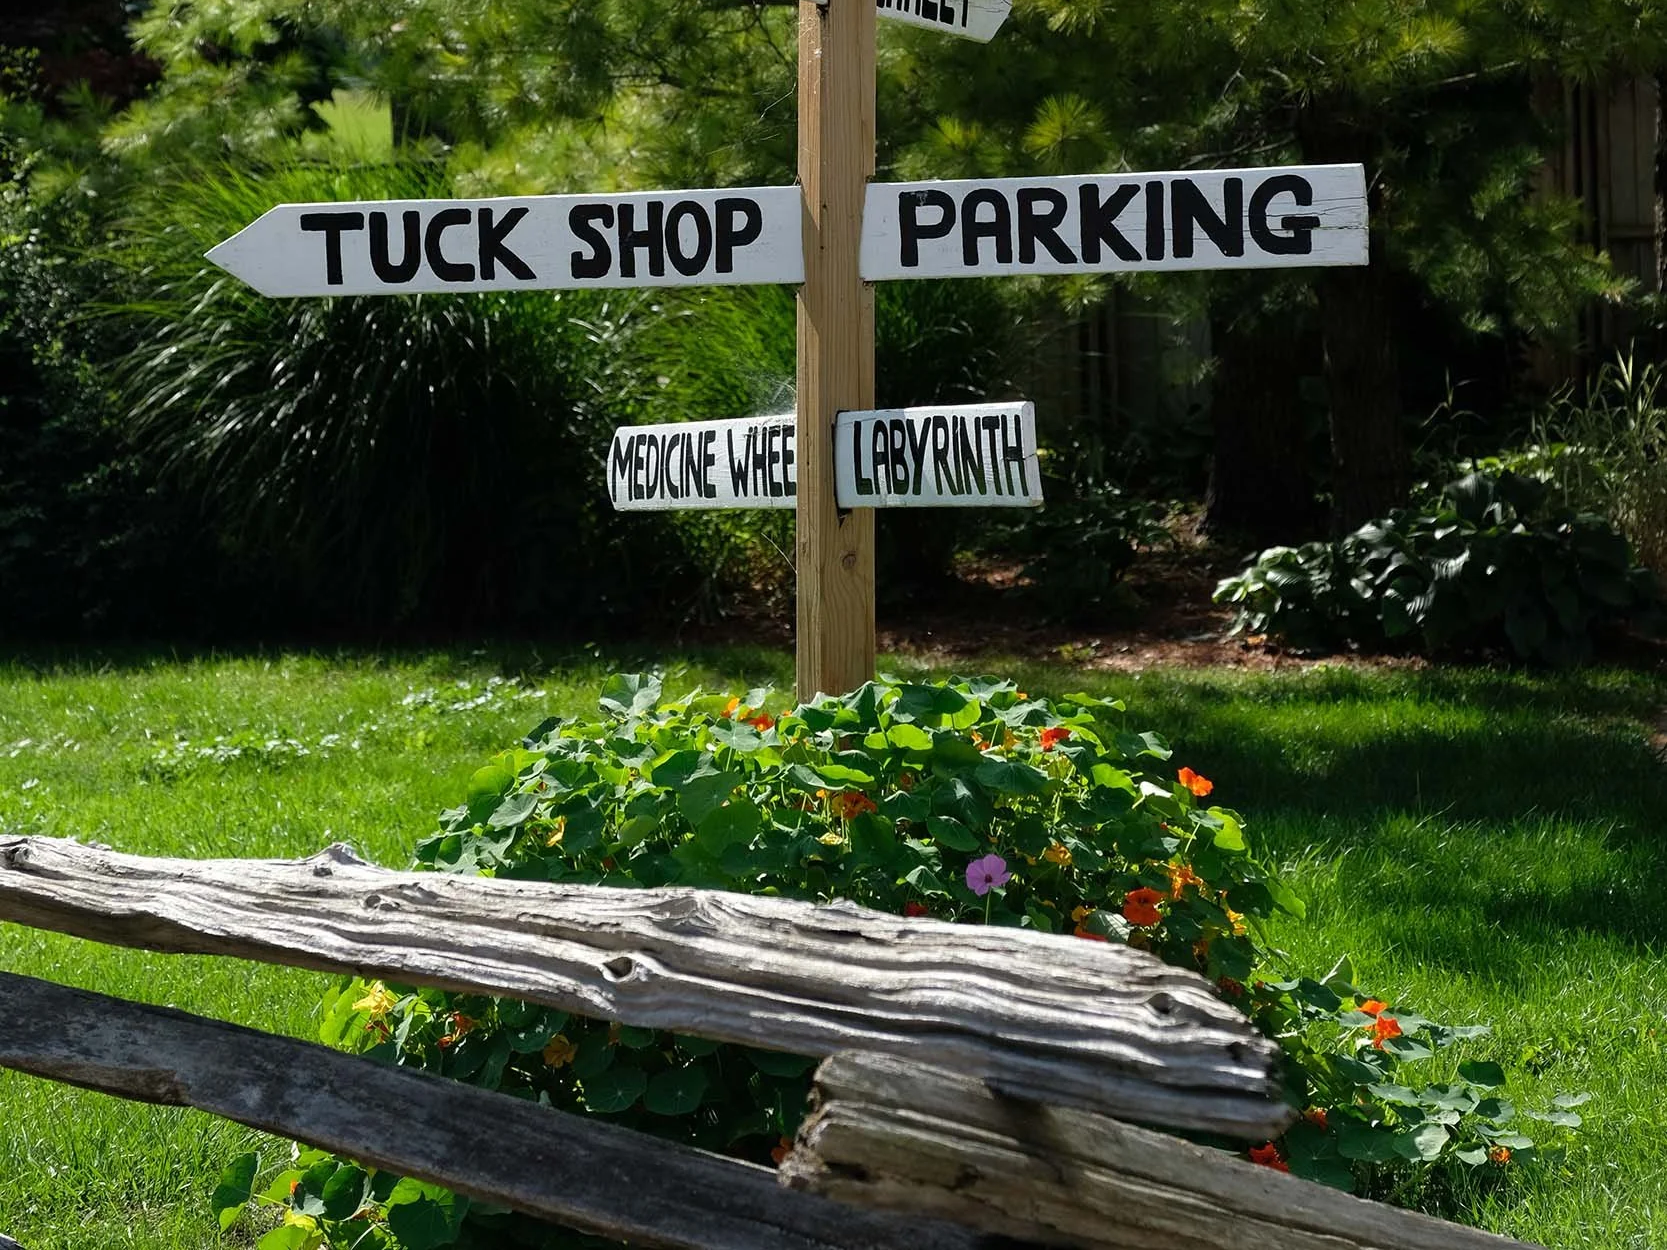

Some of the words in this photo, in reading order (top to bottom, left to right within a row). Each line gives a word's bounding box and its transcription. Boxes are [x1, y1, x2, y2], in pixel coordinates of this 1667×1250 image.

[300, 206, 537, 285] TUCK
[568, 197, 763, 278] SHOP
[898, 174, 1320, 267] PARKING
[612, 429, 717, 503] MEDICINE
[726, 424, 797, 498] WHEE
[853, 414, 1030, 497] LABYRINTH
